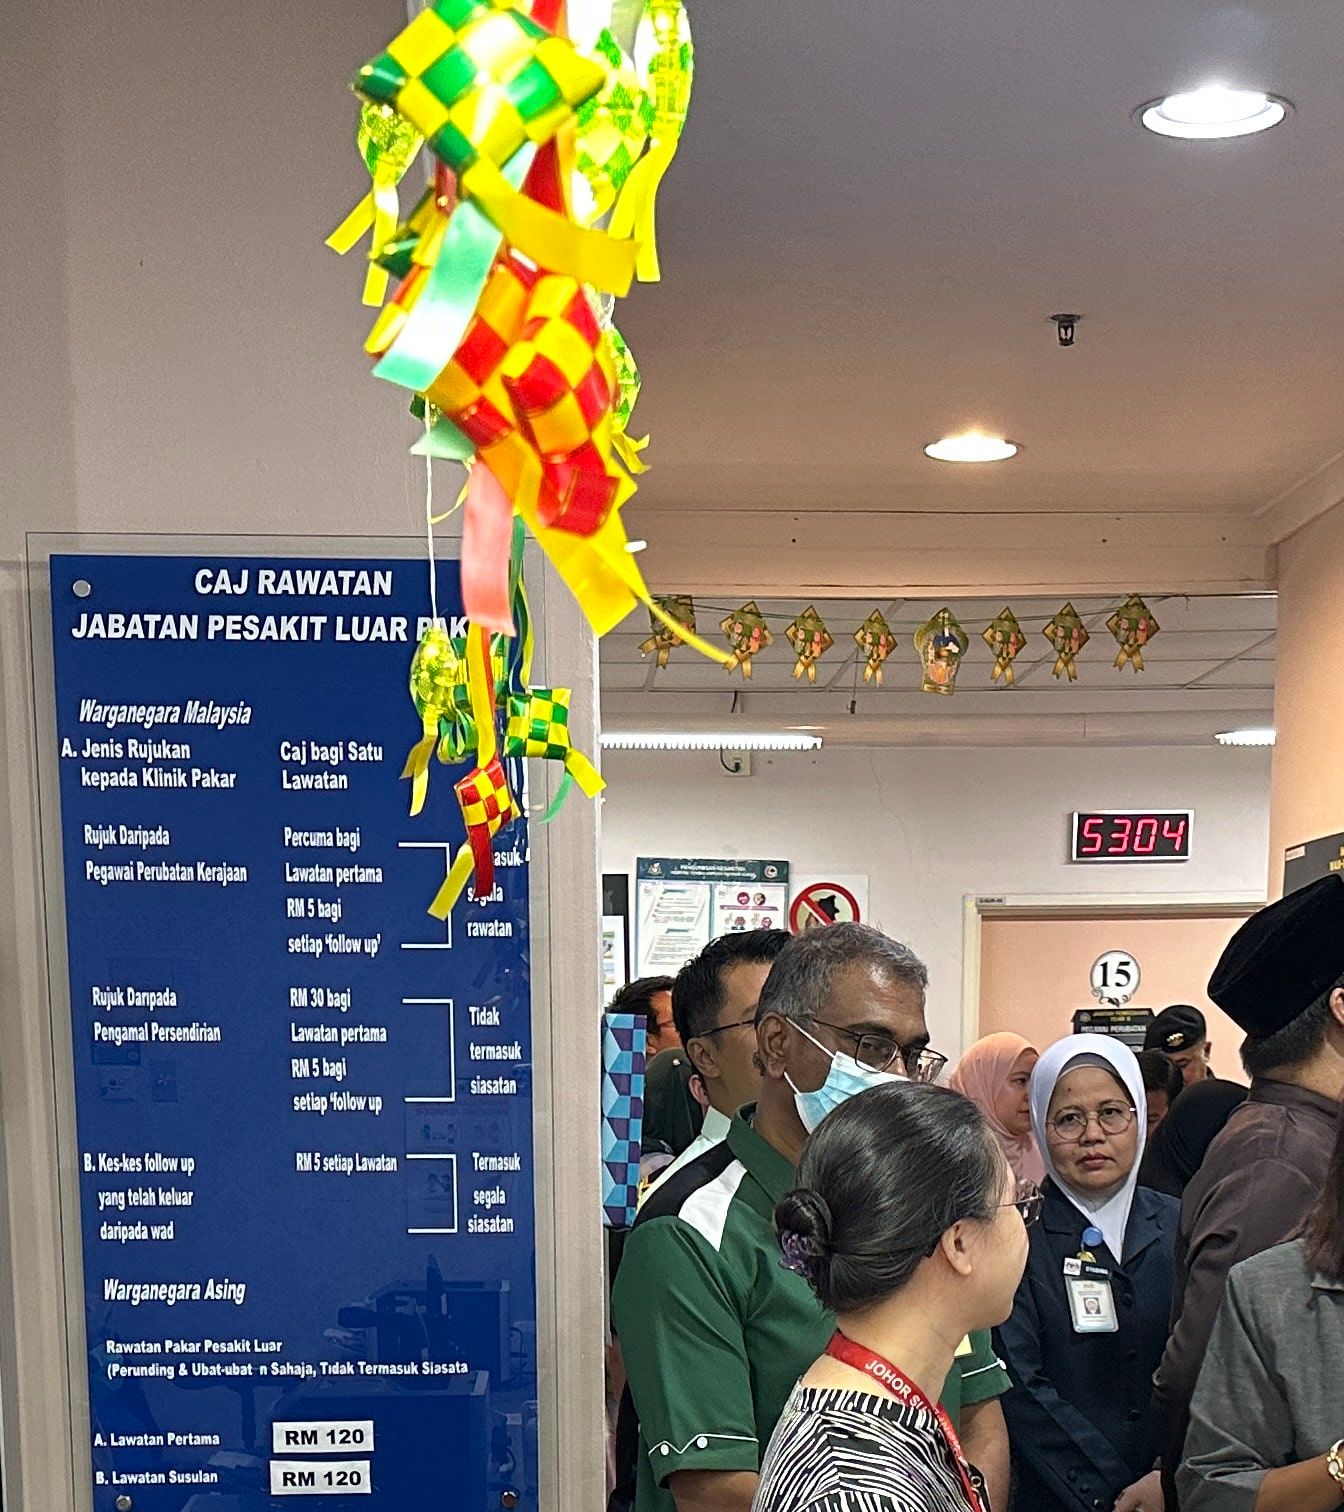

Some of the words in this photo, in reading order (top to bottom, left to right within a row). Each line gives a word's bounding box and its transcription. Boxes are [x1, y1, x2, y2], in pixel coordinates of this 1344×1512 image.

[195, 569, 248, 594] CAJ
[258, 570, 392, 595] RAWATAN
[72, 614, 198, 639] JABATAN
[208, 615, 327, 640] PESAKIT
[336, 616, 407, 641] LUAR
[80, 699, 180, 729] Warganegara
[184, 701, 251, 729] Malaysia
[62, 739, 77, 757] A.
[82, 738, 123, 758] Jenis
[128, 739, 190, 763] Rujukan
[281, 741, 306, 765] Caj
[311, 742, 343, 765] bagi
[348, 742, 382, 761] Satu
[82, 767, 137, 790] kepada
[143, 768, 187, 787] Klinik
[192, 769, 236, 787] Pakar
[283, 770, 347, 789] Lawatan
[85, 825, 116, 848] Rujuk
[120, 825, 169, 848] Daripada
[285, 827, 333, 846] Percuma
[336, 827, 360, 851] bagi
[1082, 819, 1185, 851] 5304
[86, 861, 134, 885] Pegawai
[137, 862, 194, 881] Perubatan
[197, 862, 247, 885] Kerajaan
[286, 863, 333, 882] Lawatan
[336, 865, 382, 887] pertama
[287, 898, 304, 917] RM
[308, 898, 314, 917] 5
[318, 898, 341, 922] bagi
[468, 920, 512, 936] rawatan
[289, 934, 322, 958] setiap
[1101, 962, 1130, 987] 15
[93, 987, 124, 1010] Rujuk
[290, 988, 307, 1006] RM
[311, 988, 324, 1007] 30
[327, 988, 350, 1011] bagi
[469, 1007, 499, 1025] Tidak
[94, 1022, 148, 1046] Pengamal
[152, 1023, 220, 1041] Persendirian
[292, 1023, 338, 1041] Lawatan
[341, 1025, 386, 1046] pertama
[470, 1041, 521, 1059] termasuk
[292, 1059, 309, 1077] RM
[313, 1059, 319, 1077] 5
[323, 1058, 346, 1081] bagi
[471, 1076, 516, 1094] siasatan
[294, 1093, 327, 1115] setiap
[84, 1153, 95, 1171] B.
[99, 1153, 142, 1171] Kes-kes
[145, 1153, 178, 1171] follow
[181, 1158, 194, 1176] up
[297, 1153, 312, 1171] RM
[314, 1153, 320, 1171] 5
[323, 1154, 353, 1175] setiap
[356, 1153, 397, 1171] Lawatan
[473, 1152, 520, 1170] Termasuk
[99, 1192, 125, 1210] yang
[128, 1188, 156, 1205] telah
[159, 1187, 193, 1205] keluar
[474, 1187, 505, 1209] segala
[101, 1221, 148, 1243] daripada
[151, 1221, 173, 1239] wad
[468, 1214, 513, 1232] siasatan
[105, 1279, 200, 1305] Warganegara
[204, 1279, 245, 1304] Asing
[107, 1340, 161, 1353] Rawatan
[165, 1340, 201, 1353] Pakar
[205, 1339, 250, 1352] Pesakit
[254, 1339, 282, 1352] Luar
[108, 1363, 174, 1379] (Perunding
[179, 1363, 188, 1376] &
[192, 1363, 252, 1376] Ubat-ubat
[358, 1362, 418, 1374] Termasuk
[865, 1360, 911, 1399] JOHOR
[94, 1434, 107, 1446] A.
[111, 1433, 163, 1446] Lawatan
[168, 1433, 219, 1445] Pertama
[285, 1430, 317, 1445] RM
[327, 1429, 364, 1444] 120
[96, 1471, 108, 1484] B.
[113, 1471, 165, 1484] Lawatan
[169, 1470, 217, 1483] Susulan
[283, 1472, 315, 1486] RM
[324, 1471, 361, 1485] 120
